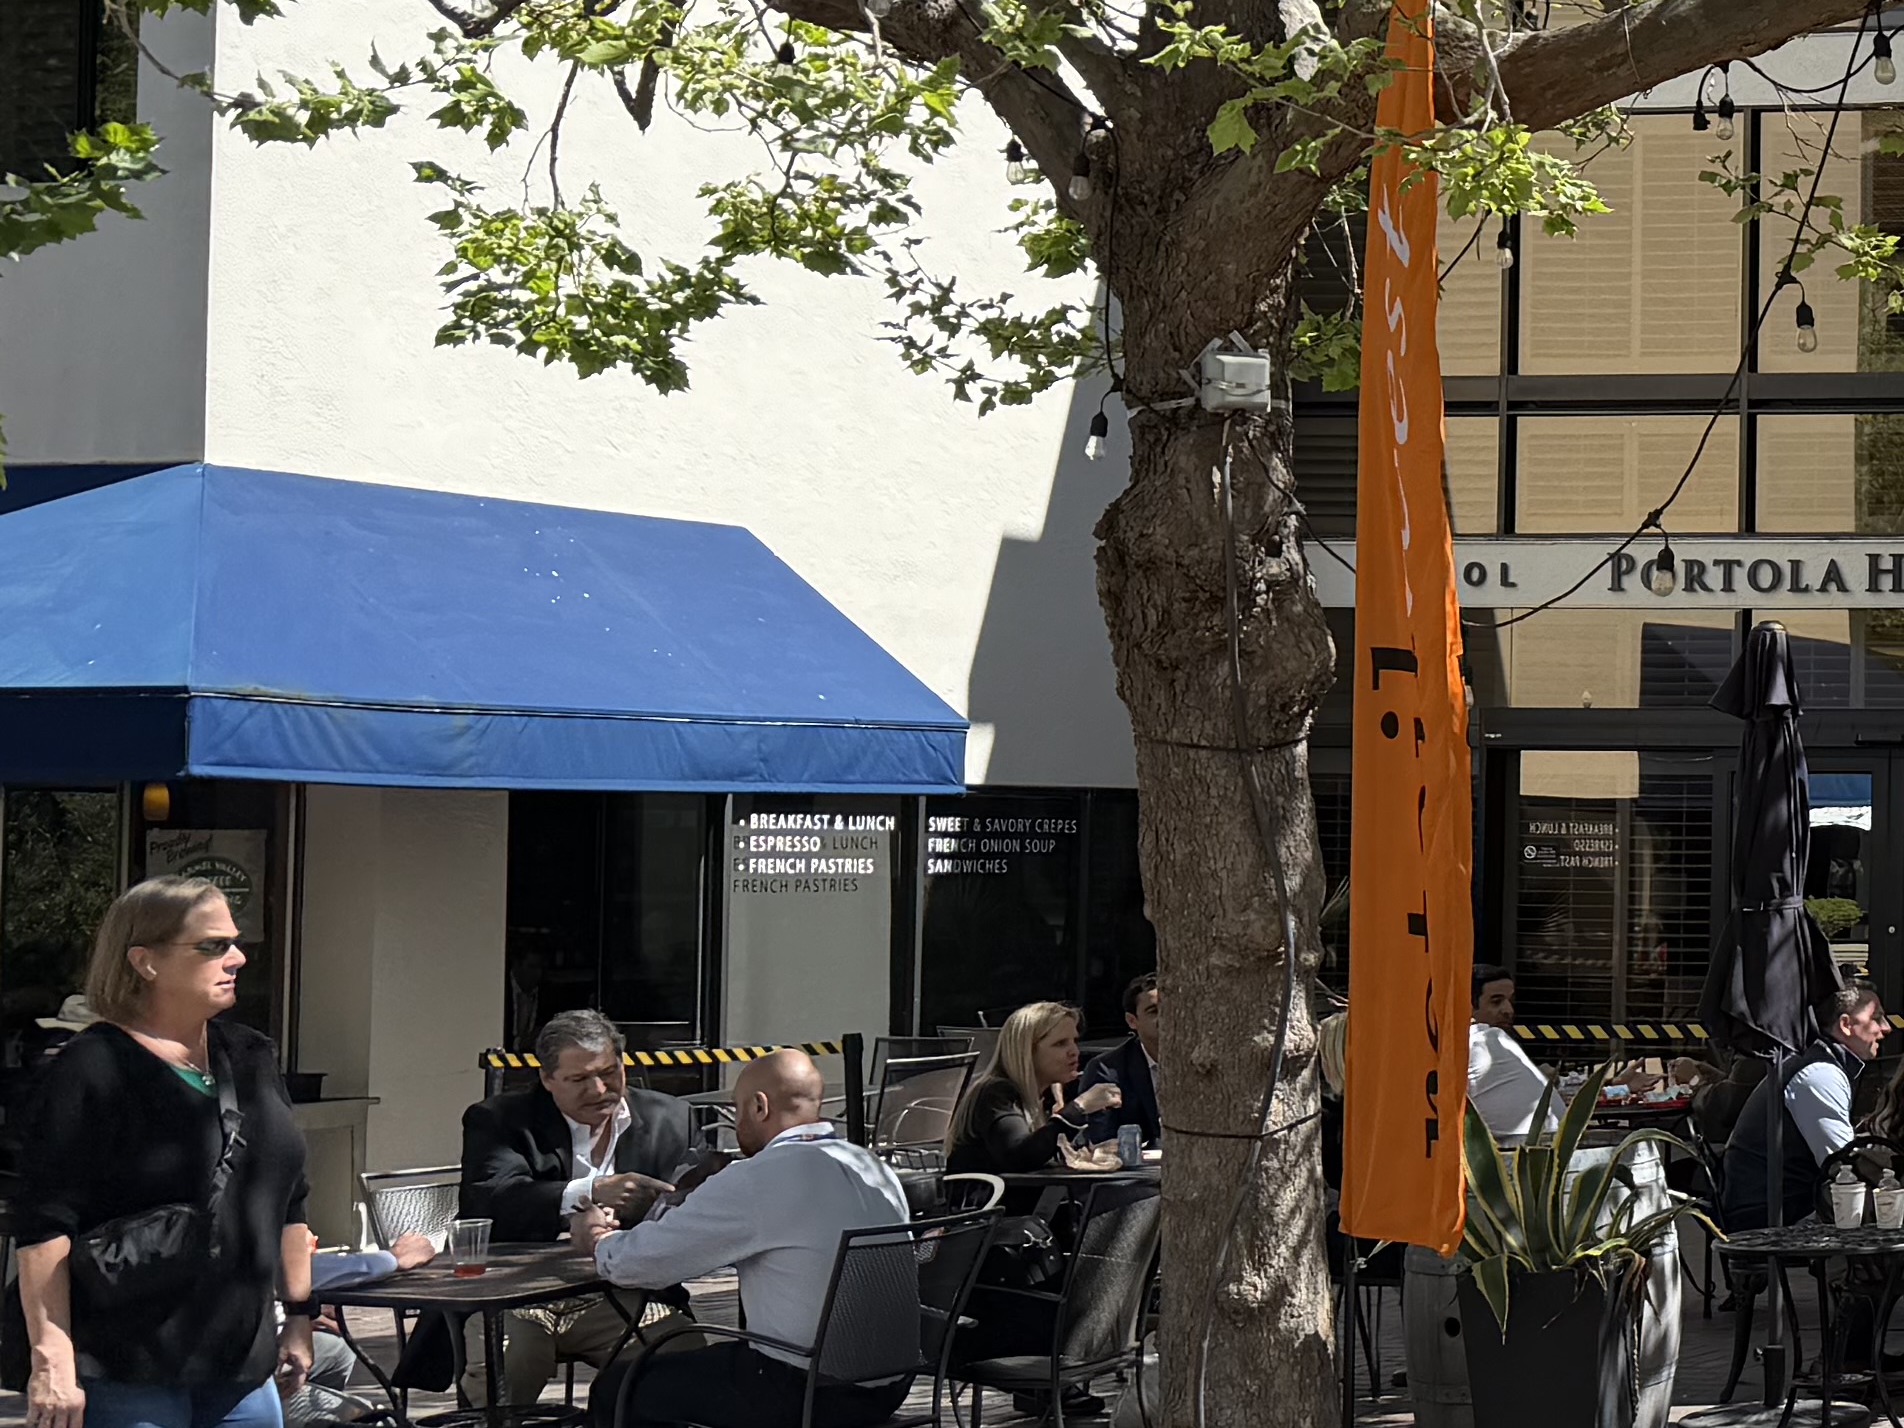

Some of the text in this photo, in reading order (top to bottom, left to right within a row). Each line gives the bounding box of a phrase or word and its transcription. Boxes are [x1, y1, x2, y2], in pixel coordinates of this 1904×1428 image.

[750, 813, 895, 831] BREAKFAST & LUNCH
[928, 816, 1077, 834] SWEET & SAVORY CREPES
[749, 836, 821, 852] ESPRESSO
[927, 838, 1056, 853] FRENCH ONION SOUP
[749, 858, 806, 874] FRENCH
[810, 858, 875, 874] PASTRIES
[927, 859, 1008, 874] SANDWICHES
[733, 878, 858, 893] FRENCH PASTRIES
